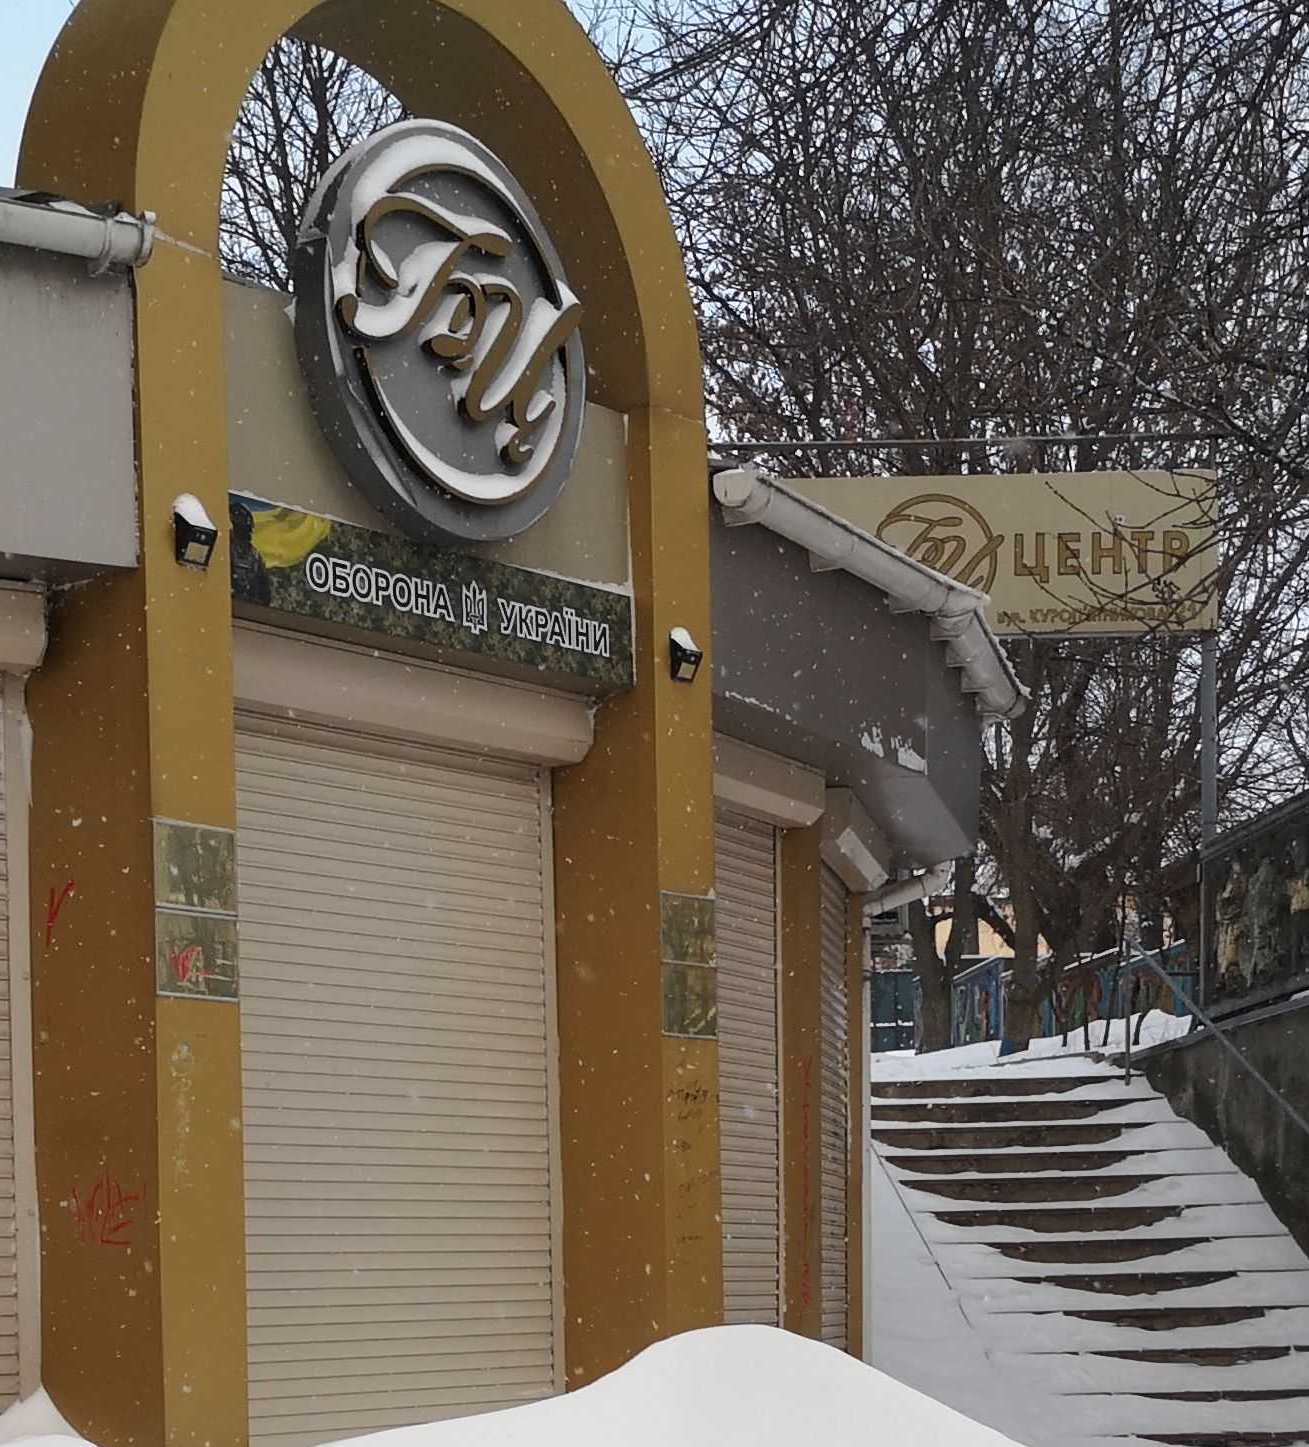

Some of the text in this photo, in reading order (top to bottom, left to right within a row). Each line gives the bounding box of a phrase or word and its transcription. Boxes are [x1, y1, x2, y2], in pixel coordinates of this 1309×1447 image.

[1014, 530, 1190, 584] ЦЕНТР
[305, 552, 610, 657] ОБОРОНА УКРАЇНИ
